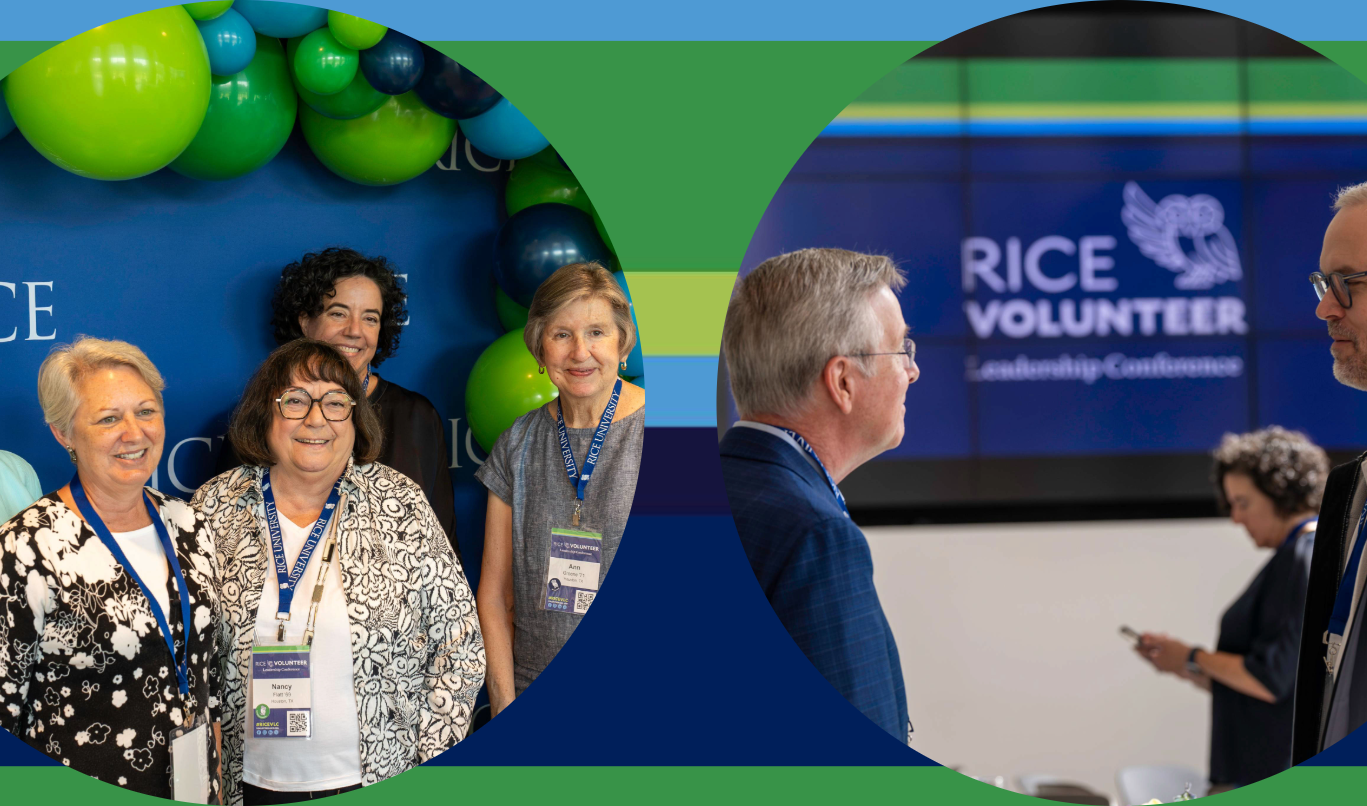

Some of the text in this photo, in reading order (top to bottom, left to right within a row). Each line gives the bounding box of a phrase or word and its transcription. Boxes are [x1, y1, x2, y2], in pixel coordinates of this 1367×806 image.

[960, 235, 1119, 293] RICE
[962, 296, 1249, 339] VOLUNTEER
[1102, 352, 1244, 380] Conference
[558, 426, 578, 479] UNIVERSITY
[586, 389, 620, 465] RICE UNIVERSITY
[265, 501, 287, 574] RICE UNIVERSITY
[288, 517, 328, 592] RICE UNIVERSITY
[271, 683, 292, 691] Nancy
